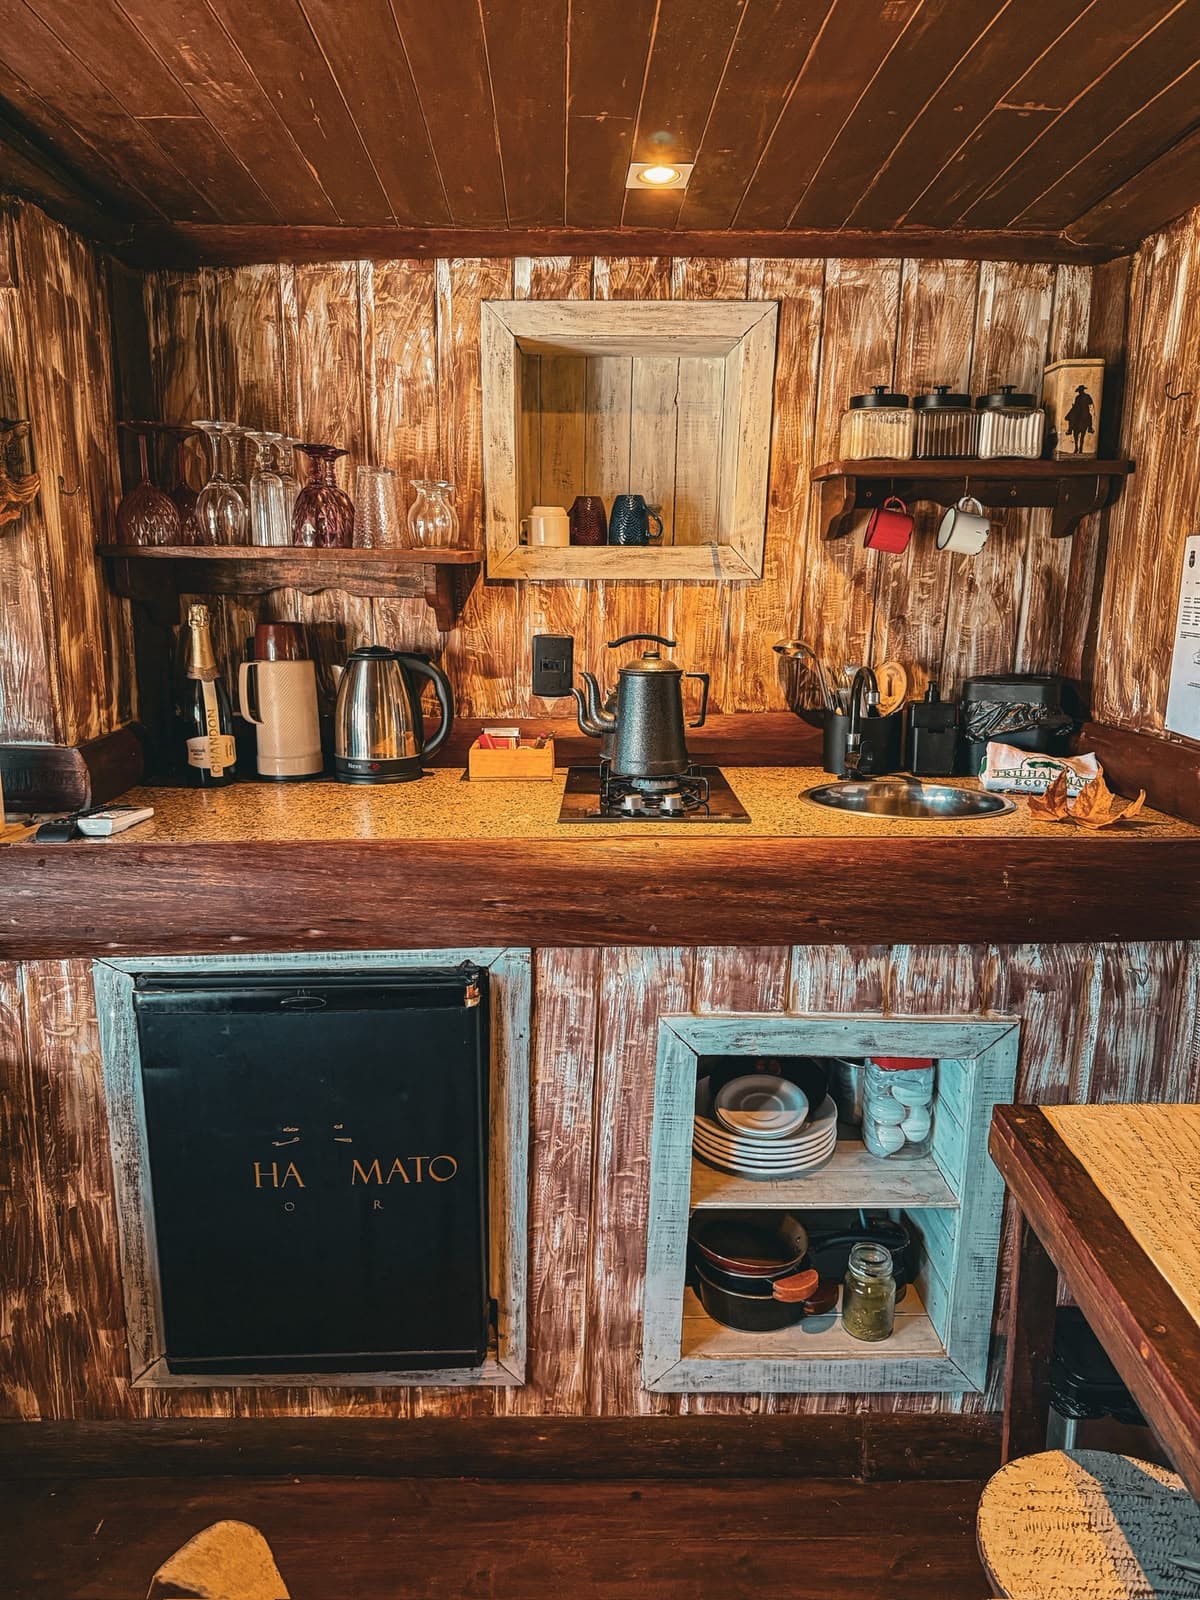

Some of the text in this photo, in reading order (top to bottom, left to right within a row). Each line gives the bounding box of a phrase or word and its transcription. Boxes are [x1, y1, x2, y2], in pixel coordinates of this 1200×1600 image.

[207, 709, 221, 773] CHANDON
[994, 769, 1047, 778] TRILHA
[254, 1155, 458, 1188] HA MATO
